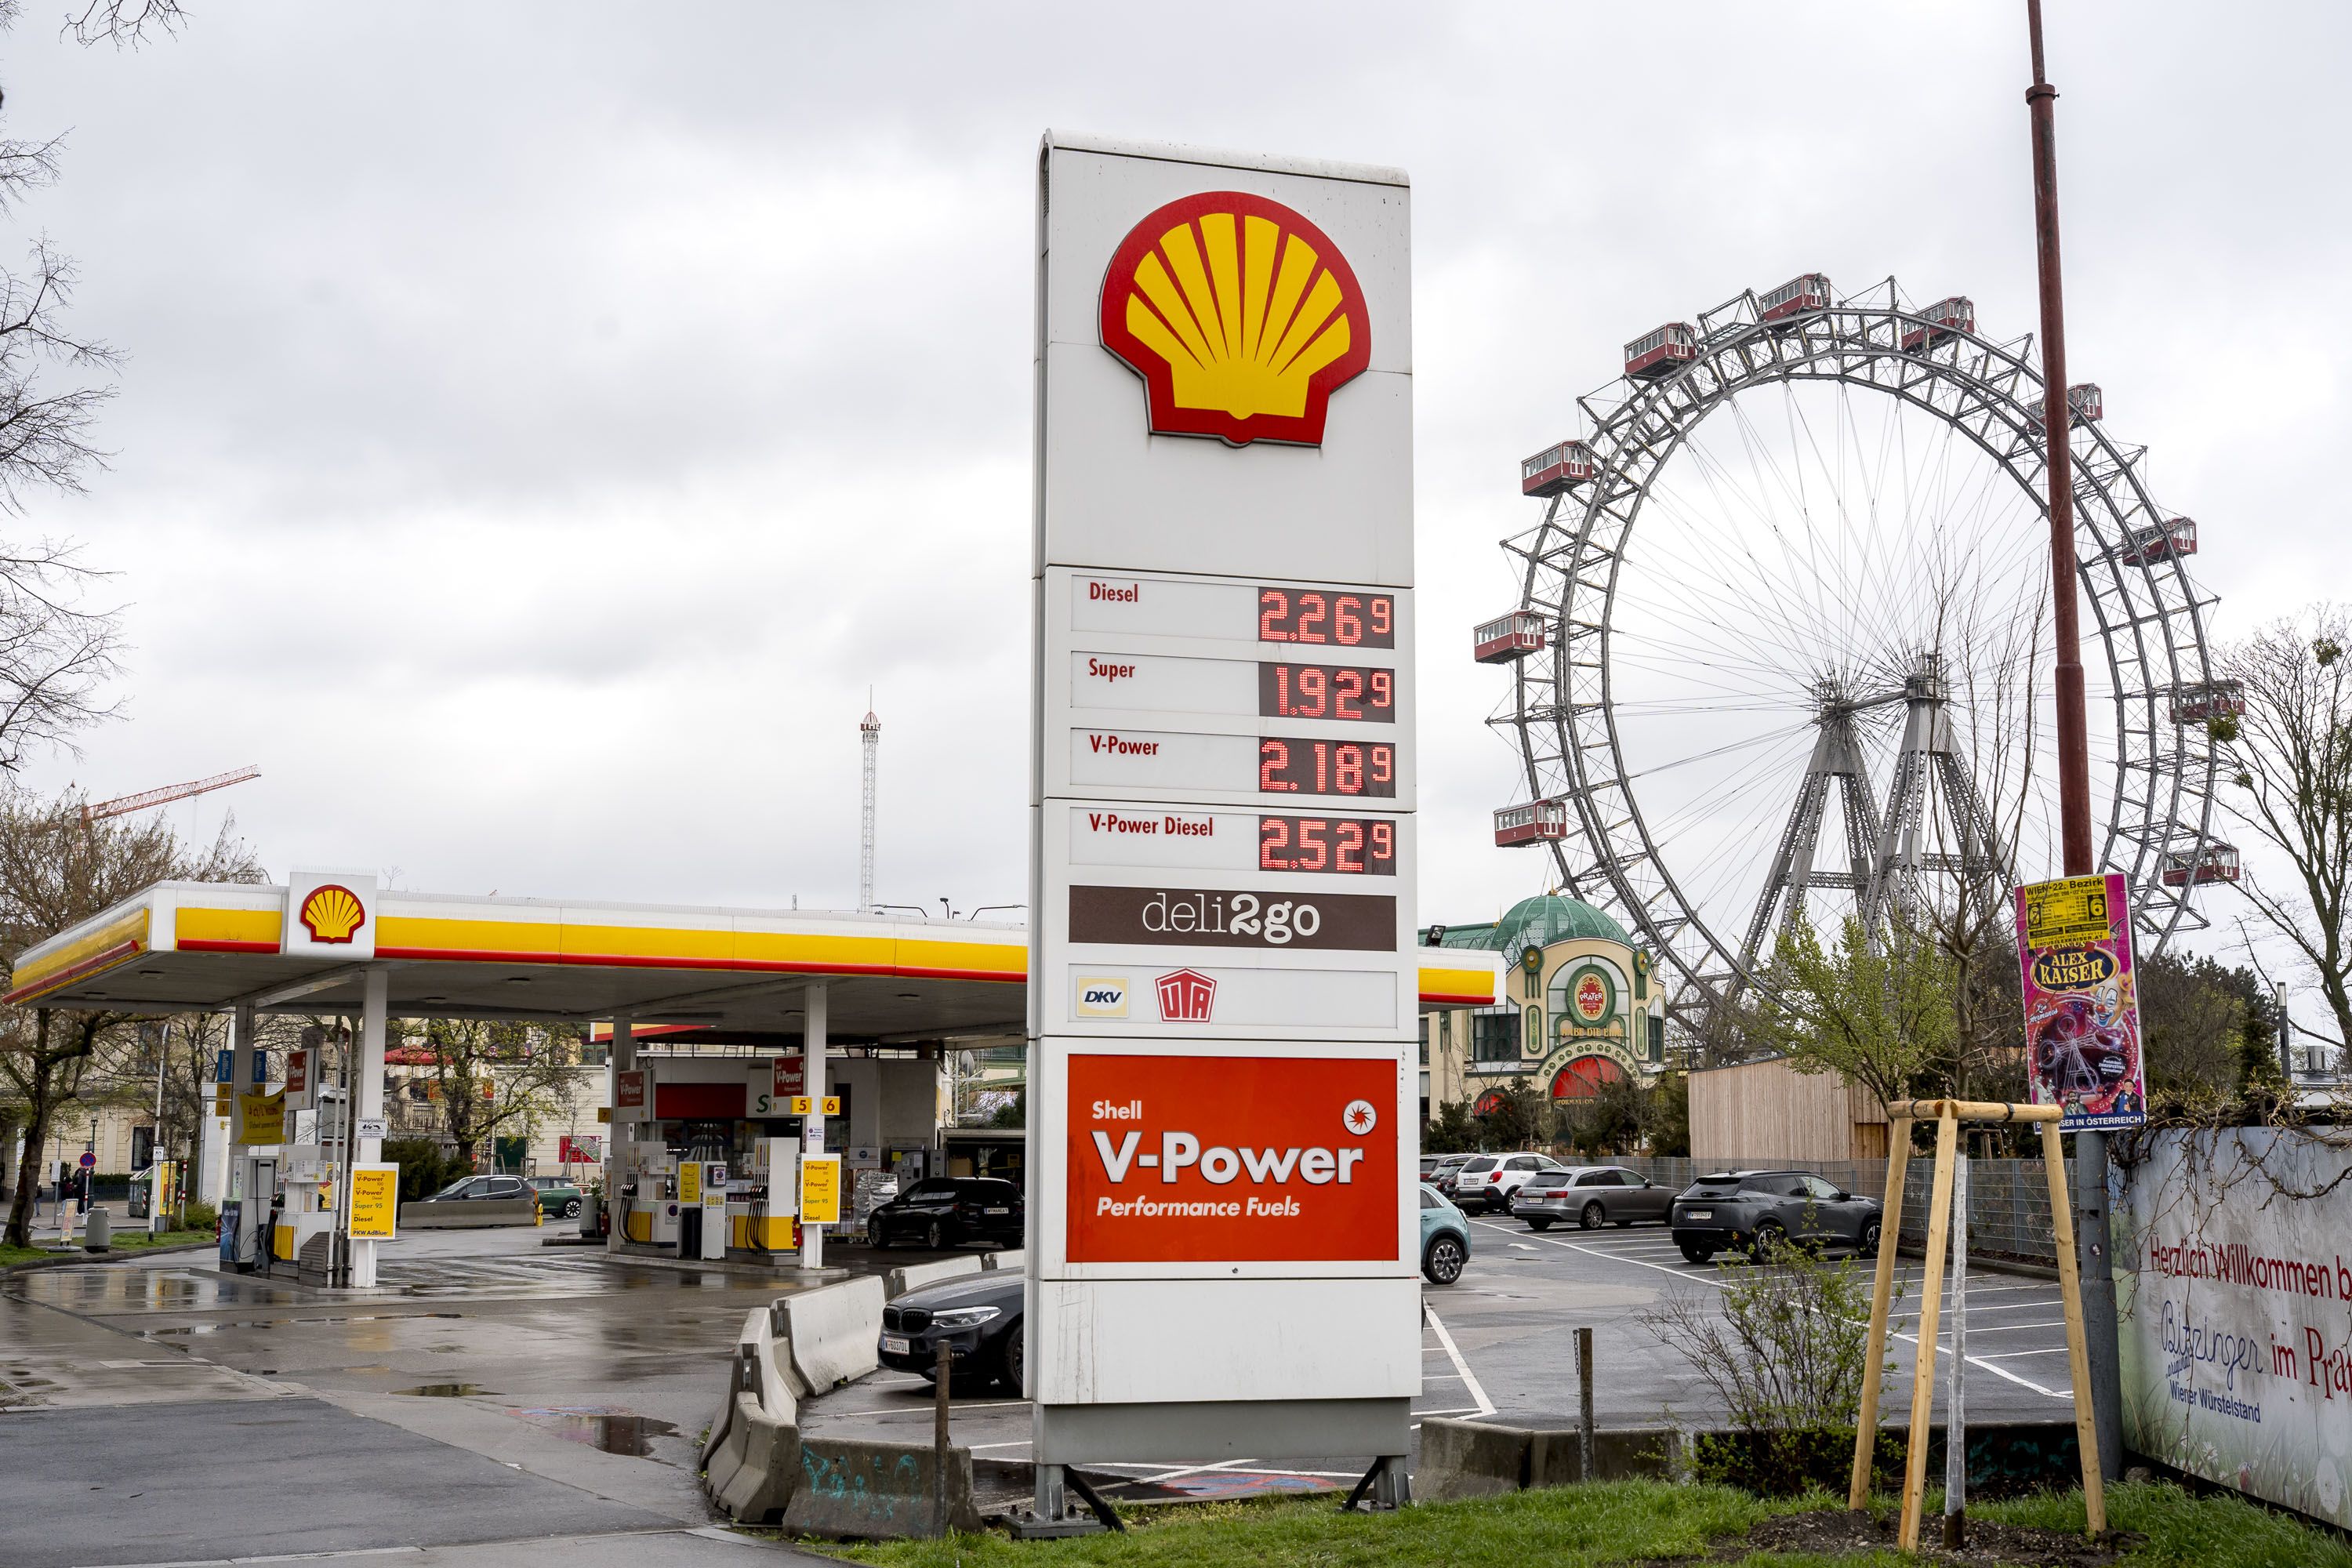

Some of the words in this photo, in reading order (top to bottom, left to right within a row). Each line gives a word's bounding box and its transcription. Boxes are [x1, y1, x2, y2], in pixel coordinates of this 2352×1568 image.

[1089, 582, 1139, 603] Diesel
[1088, 658, 1136, 682] Super
[1089, 734, 1160, 757] V-Power
[1088, 813, 1159, 835] V-Power
[1164, 815, 1214, 837] Diesel
[2069, 877, 2104, 889] Bezirk
[2090, 898, 2104, 916] 6
[1142, 892, 1320, 944] deli2go
[2051, 951, 2089, 967] ALEX
[2039, 958, 2106, 985] KAISER
[1084, 989, 1122, 1004] DKV
[1159, 971, 1214, 1021] UTA
[1579, 992, 1603, 1001] PRATER
[775, 1070, 803, 1083] V-Power
[620, 1084, 642, 1095] V-Power
[798, 1099, 808, 1112] 5
[826, 1099, 836, 1112] 6
[1091, 1100, 1142, 1120] Shell
[2086, 1116, 2142, 1126] ÖSTERREICH
[1091, 1130, 1365, 1185] V-Power
[1097, 1196, 1240, 1217] Performance
[1246, 1196, 1301, 1217] Fuels
[2150, 1236, 2209, 1280] Herzlich
[2211, 1243, 2333, 1299] Willkommen
[2270, 1333, 2298, 1381] im
[2169, 1379, 2198, 1406] Wiener
[2198, 1387, 2261, 1424] Würstelstand
